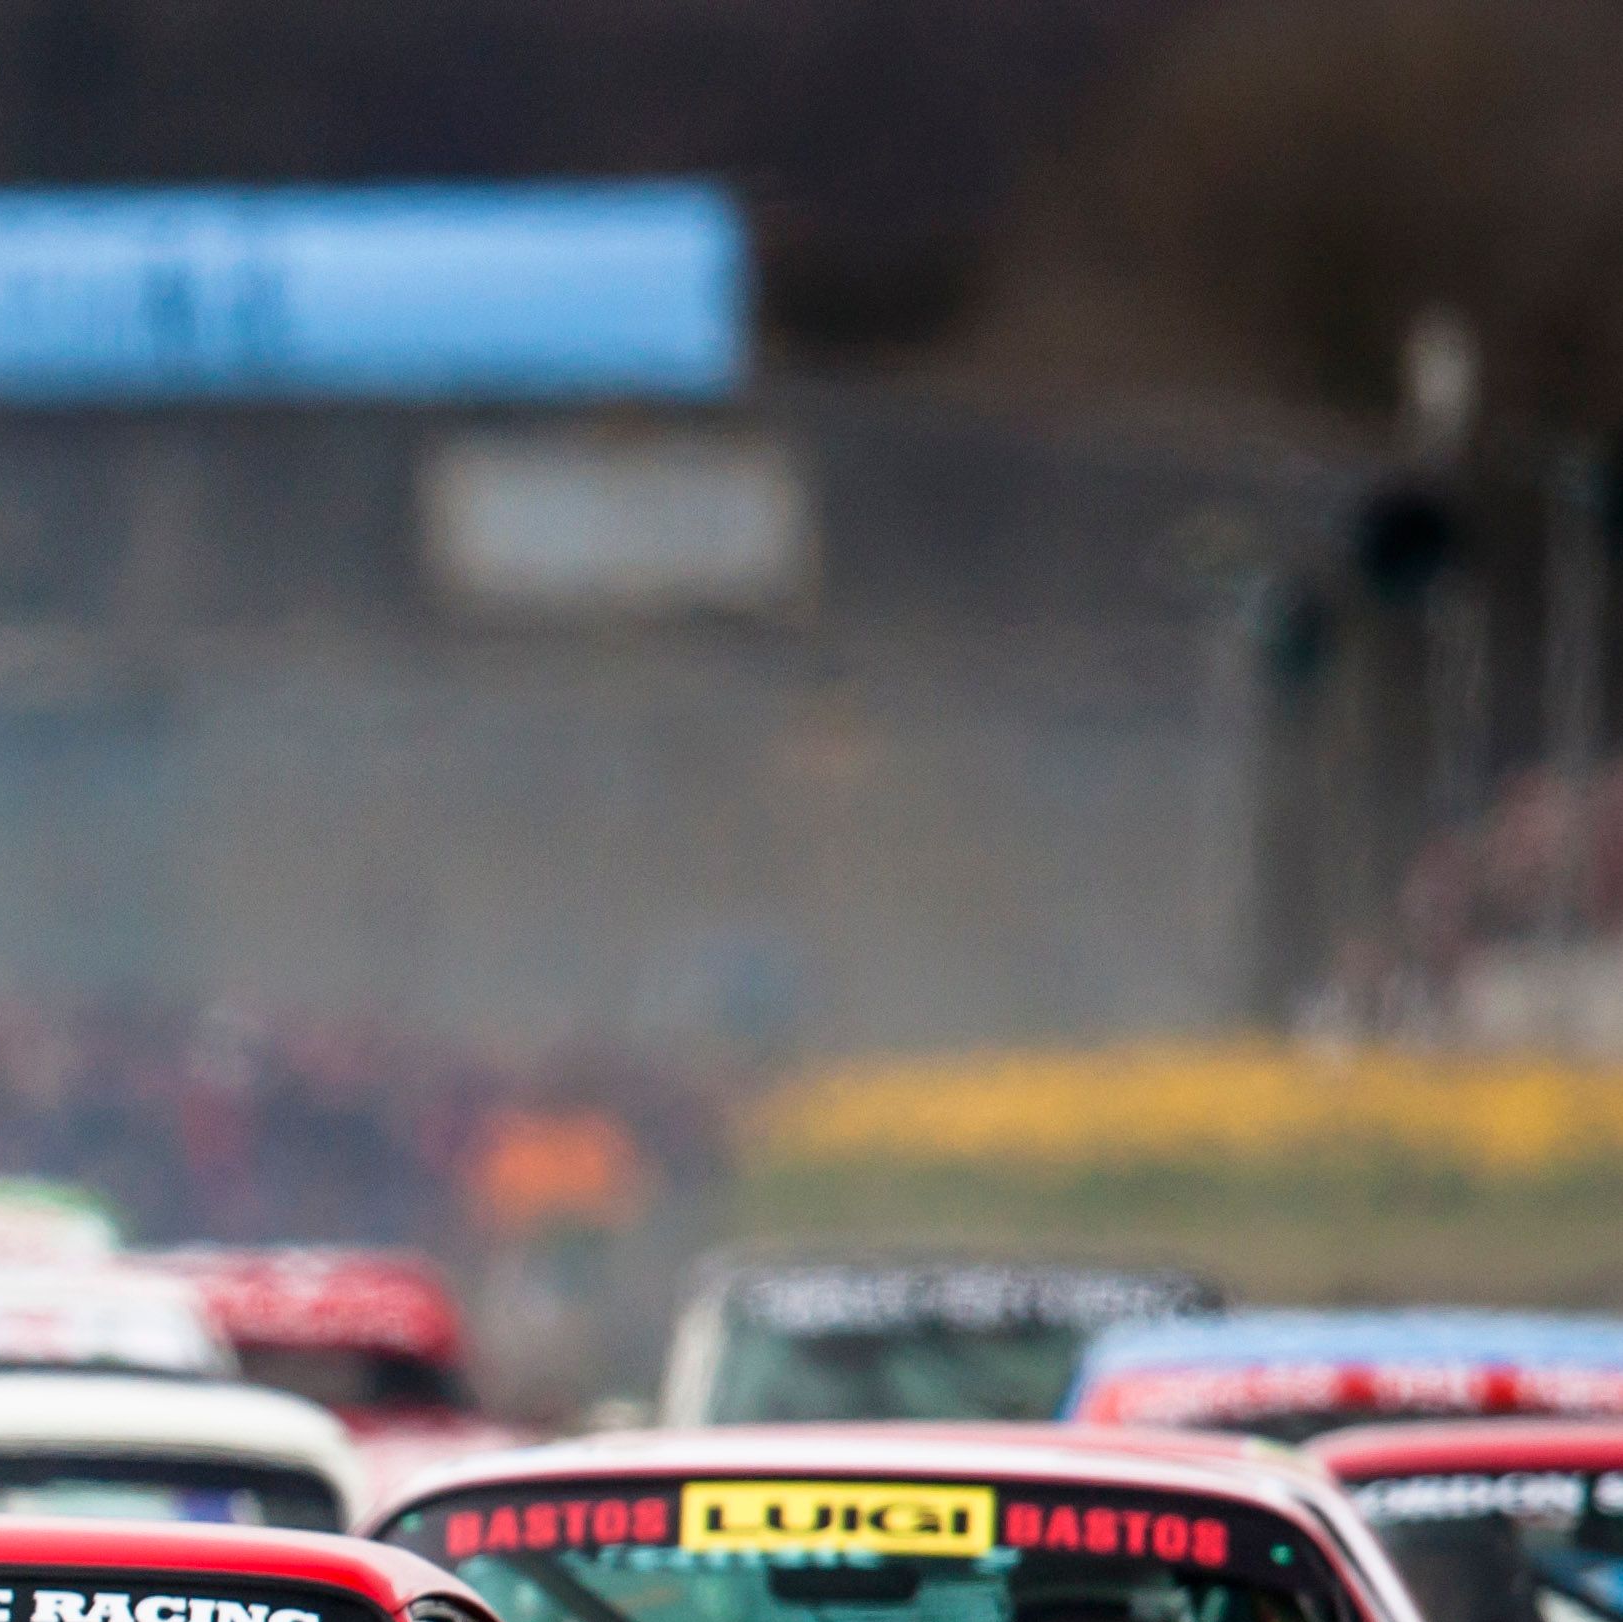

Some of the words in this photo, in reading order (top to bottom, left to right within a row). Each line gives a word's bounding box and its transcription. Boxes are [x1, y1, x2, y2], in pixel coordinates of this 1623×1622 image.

[445, 1497, 667, 1555] BASTOS
[705, 1503, 973, 1537] LUIGI
[1005, 1502, 1228, 1568] BASTOS
